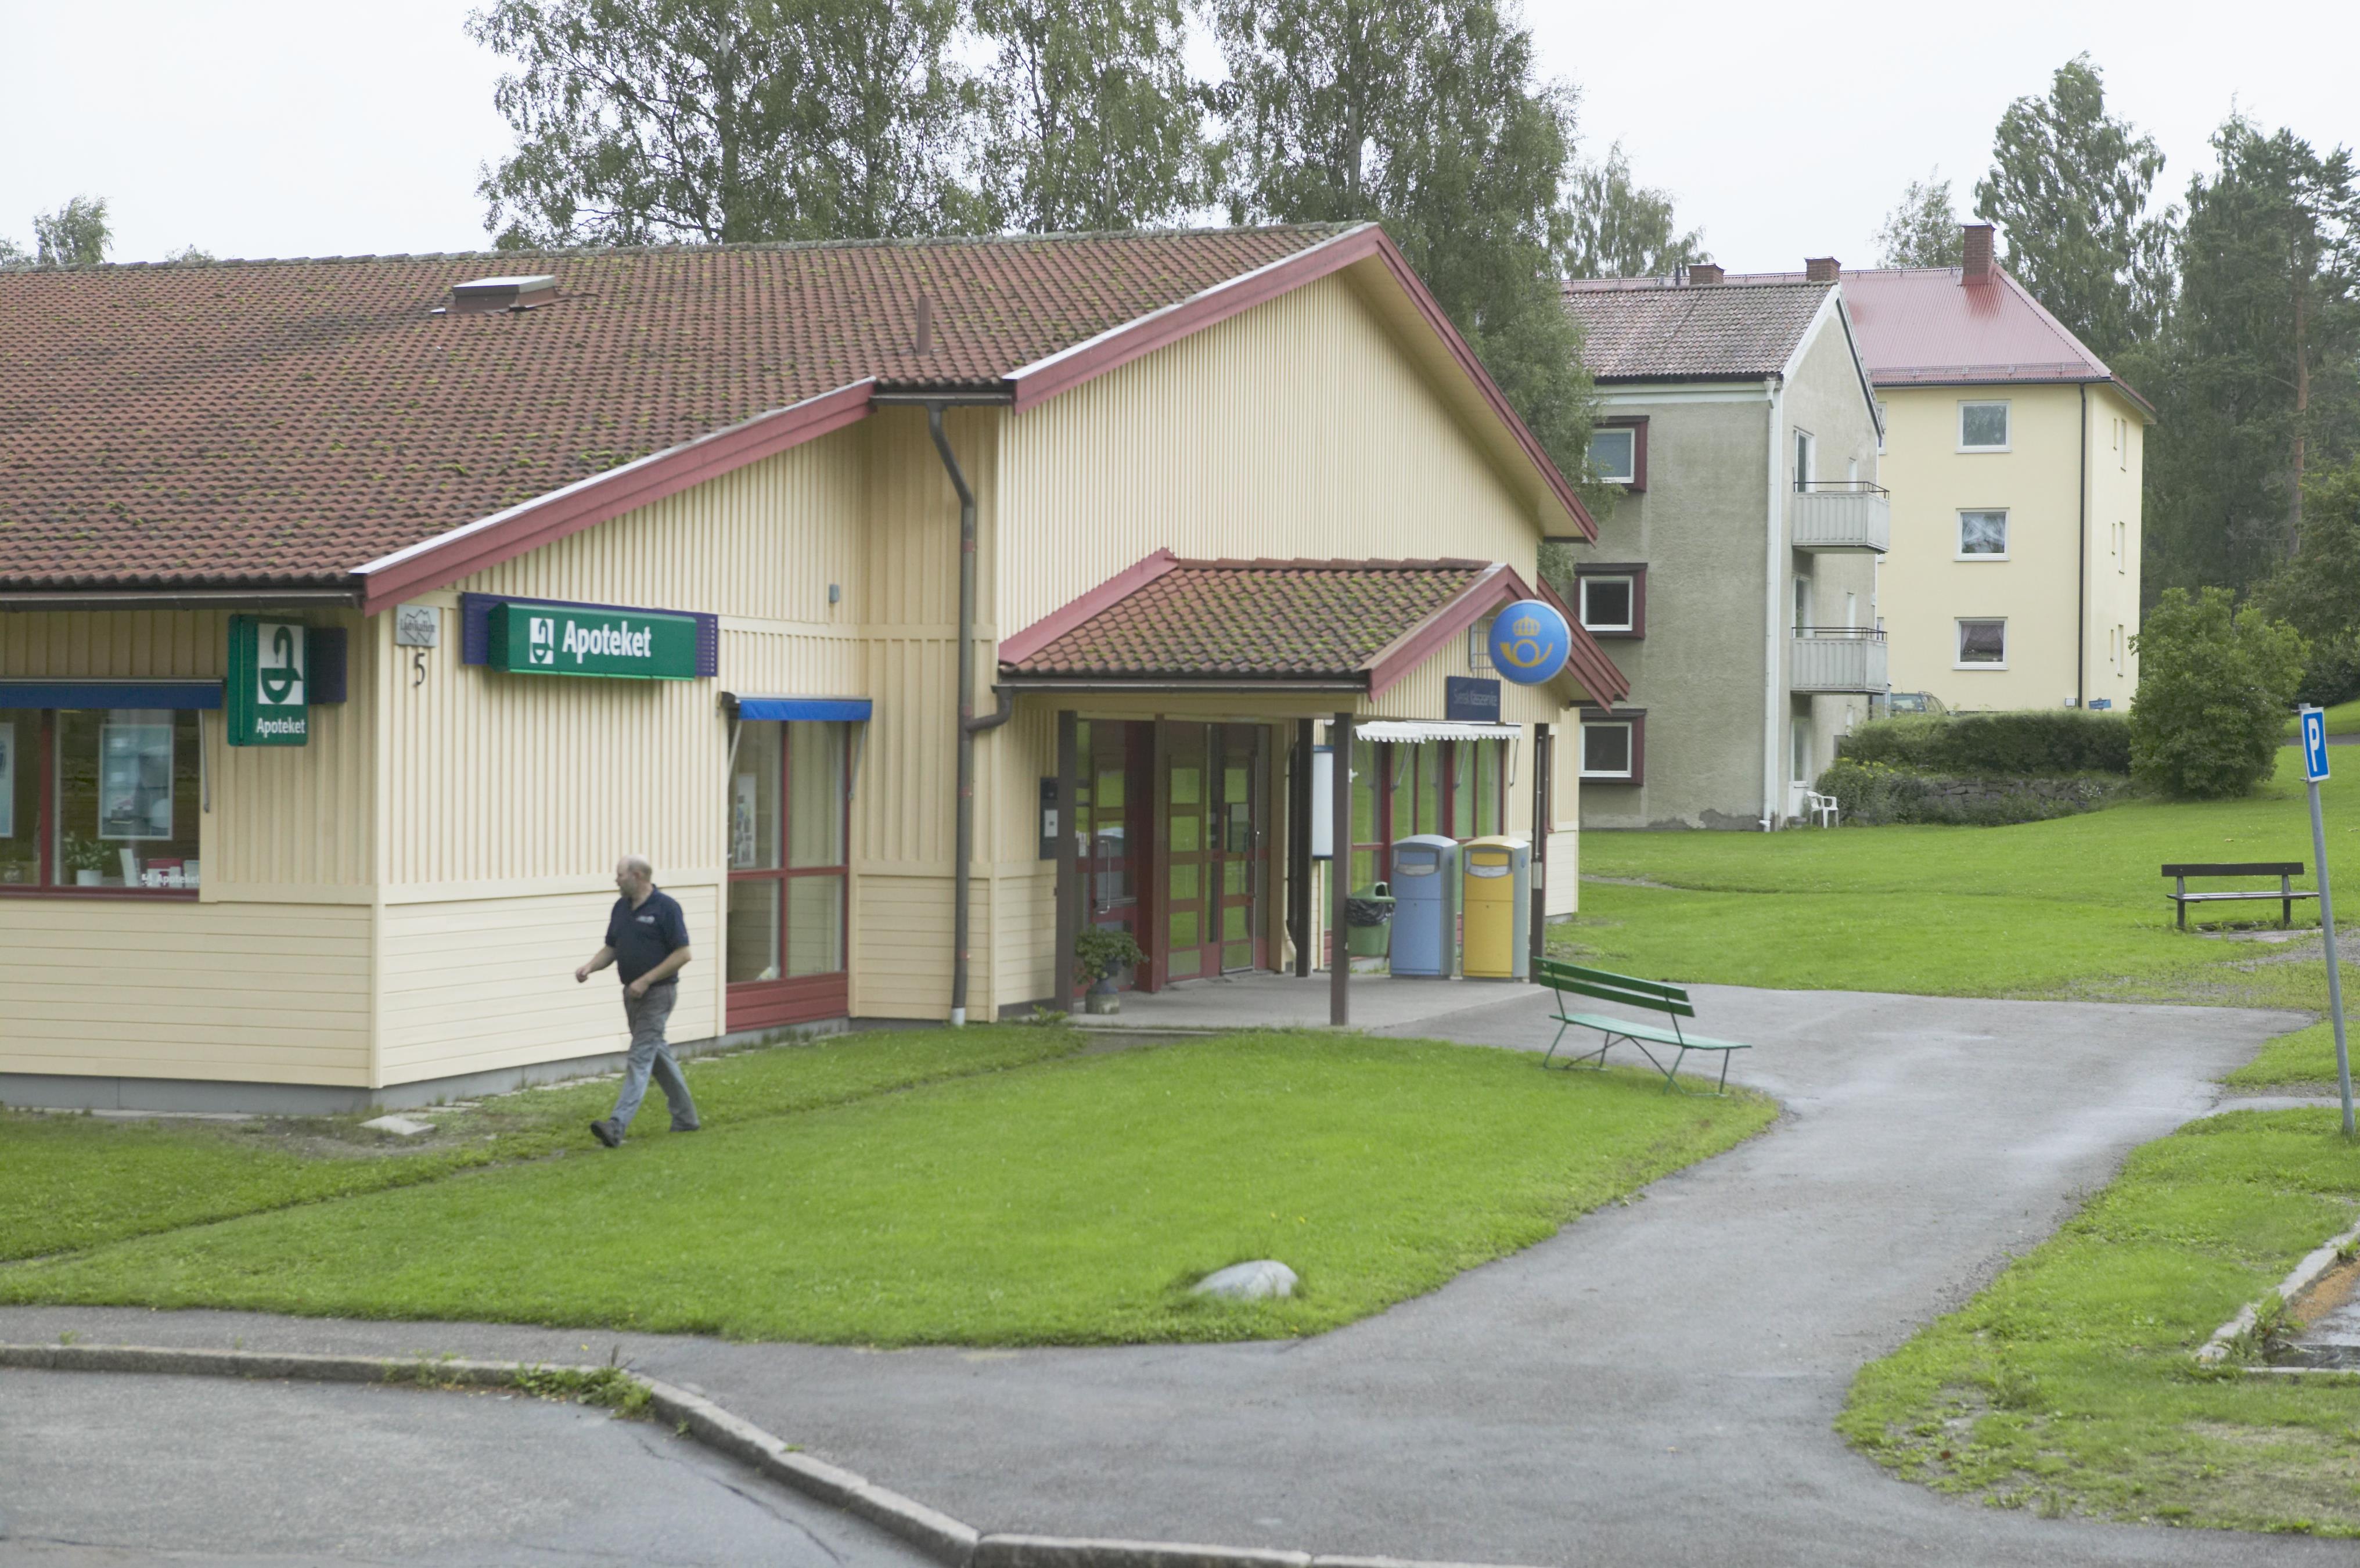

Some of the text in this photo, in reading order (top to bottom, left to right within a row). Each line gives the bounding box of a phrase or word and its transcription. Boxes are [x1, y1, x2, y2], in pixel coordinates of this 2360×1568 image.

[562, 620, 652, 664] Apoteket
[413, 653, 426, 688] 5
[256, 716, 305, 738] Apoteket
[2308, 718, 2320, 772] P
